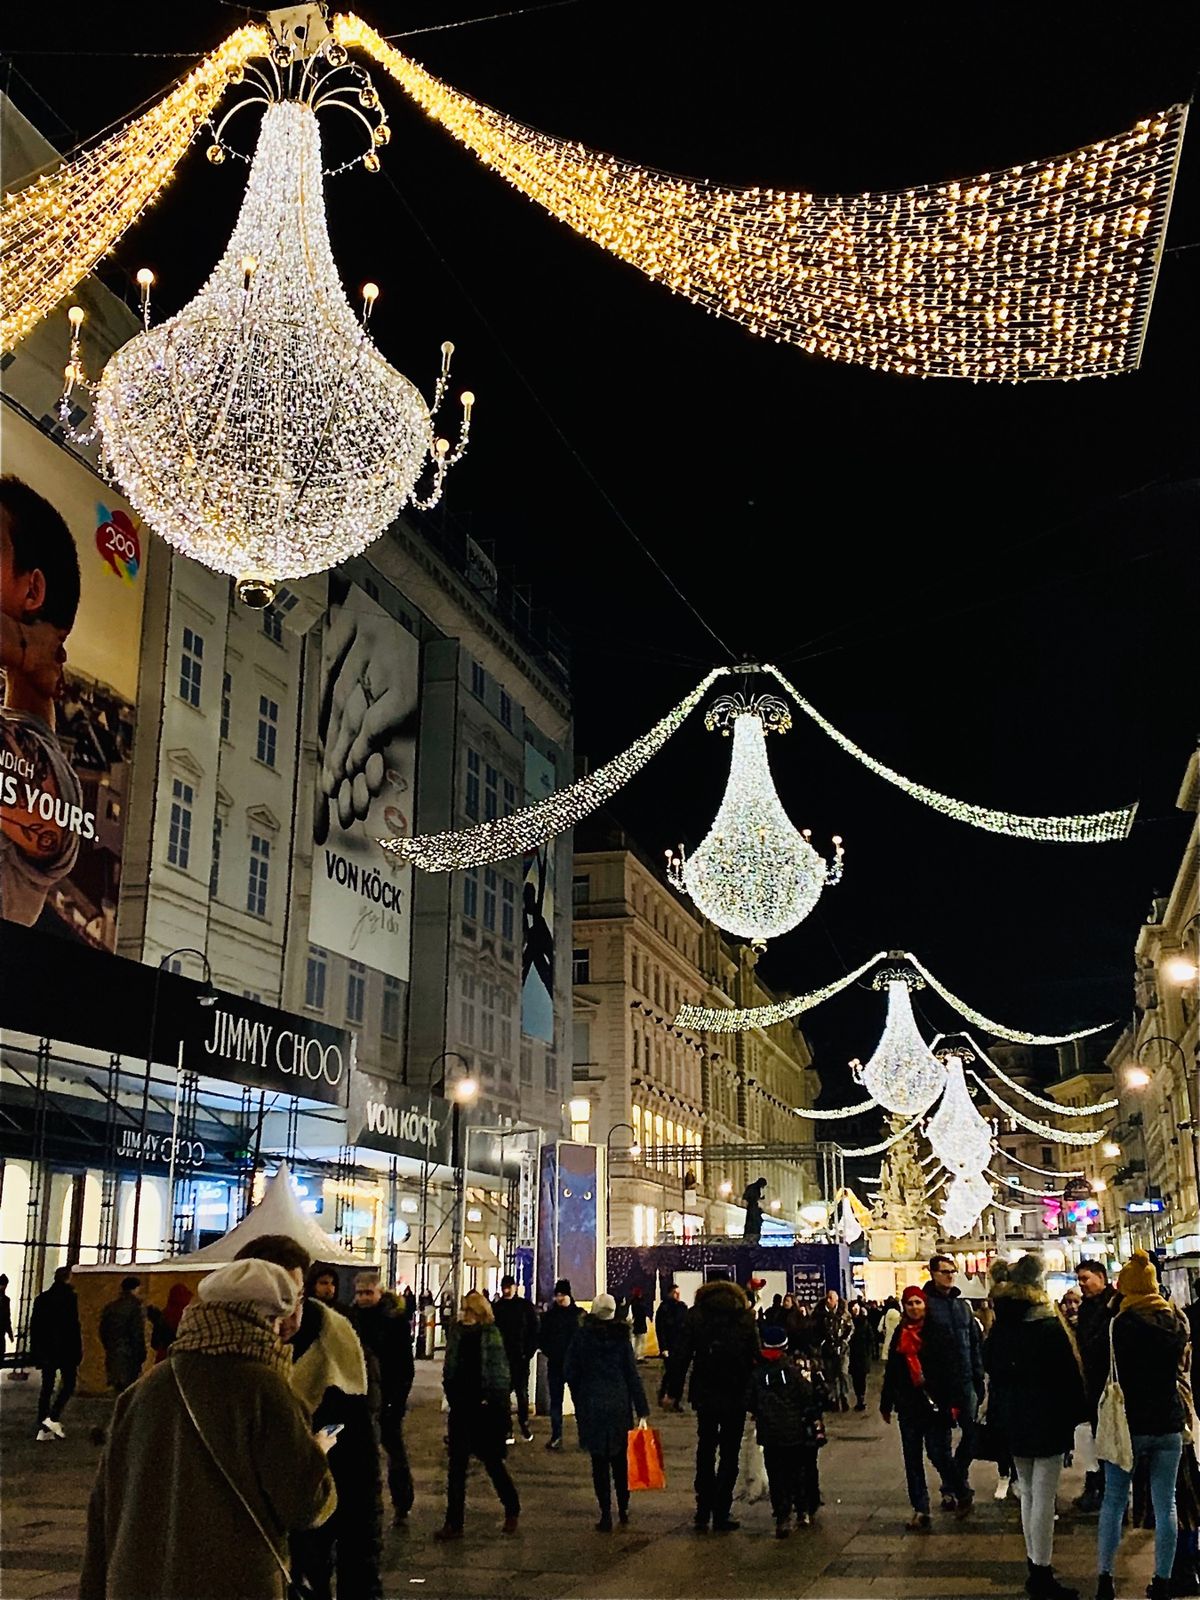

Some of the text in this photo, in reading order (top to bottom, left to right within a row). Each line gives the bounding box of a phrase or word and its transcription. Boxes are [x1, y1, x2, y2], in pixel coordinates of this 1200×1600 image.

[105, 526, 135, 558] 200
[25, 783, 99, 843] YOURS.
[326, 849, 402, 915] VON KÖCK
[204, 1009, 343, 1086] JIMMY CHOO
[366, 1100, 438, 1148] VON KÖCK
